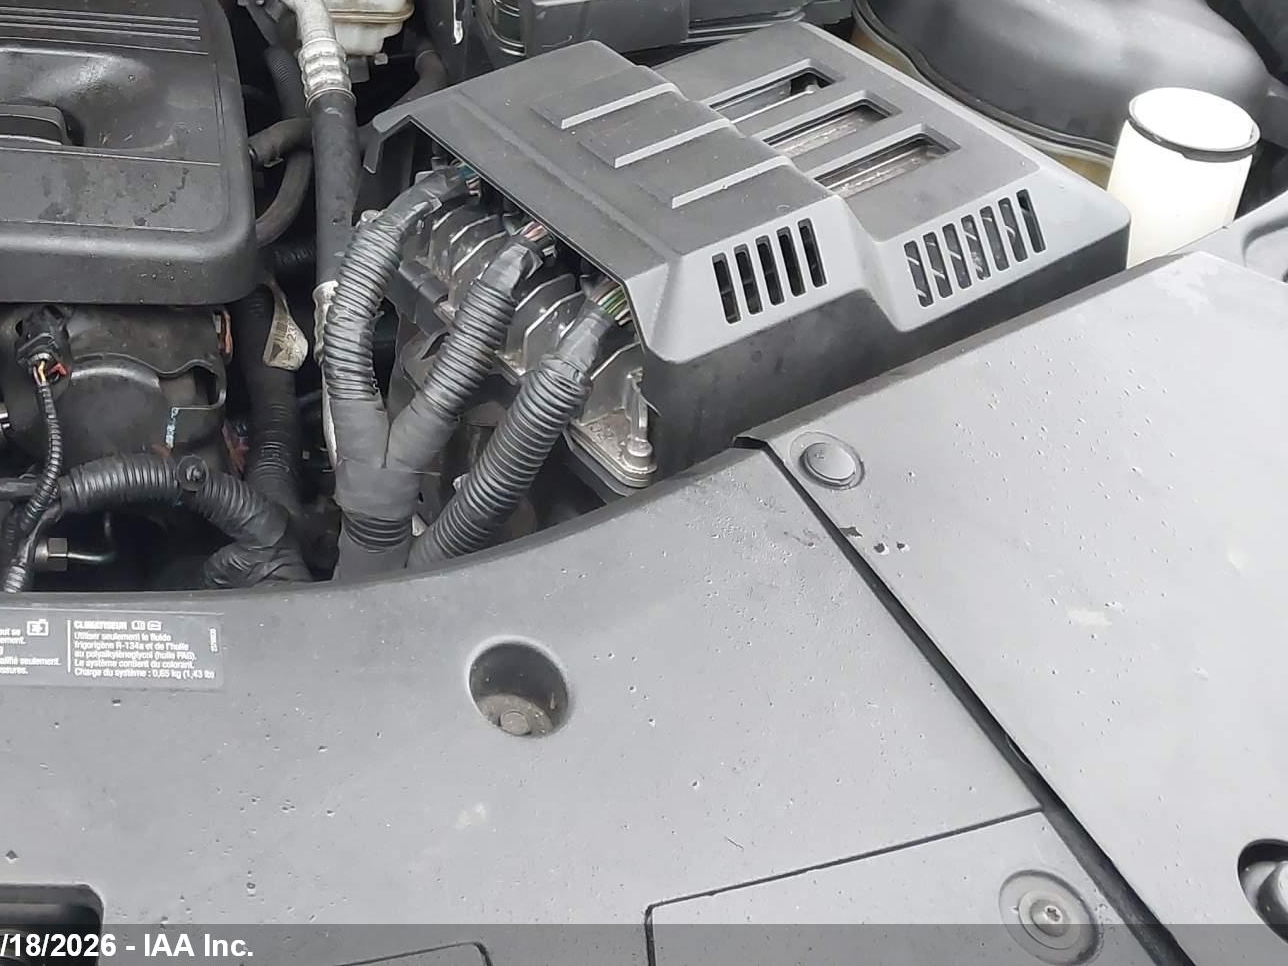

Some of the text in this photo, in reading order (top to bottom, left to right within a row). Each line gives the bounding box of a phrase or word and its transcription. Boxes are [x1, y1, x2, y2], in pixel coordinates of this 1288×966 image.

[102, 632, 140, 642] seulement
[116, 642, 144, 650] R-134a
[154, 642, 164, 650] de
[74, 659, 84, 667] Le
[150, 660, 160, 668] du
[74, 668, 102, 678] Charge
[171, 670, 182, 679] kg
